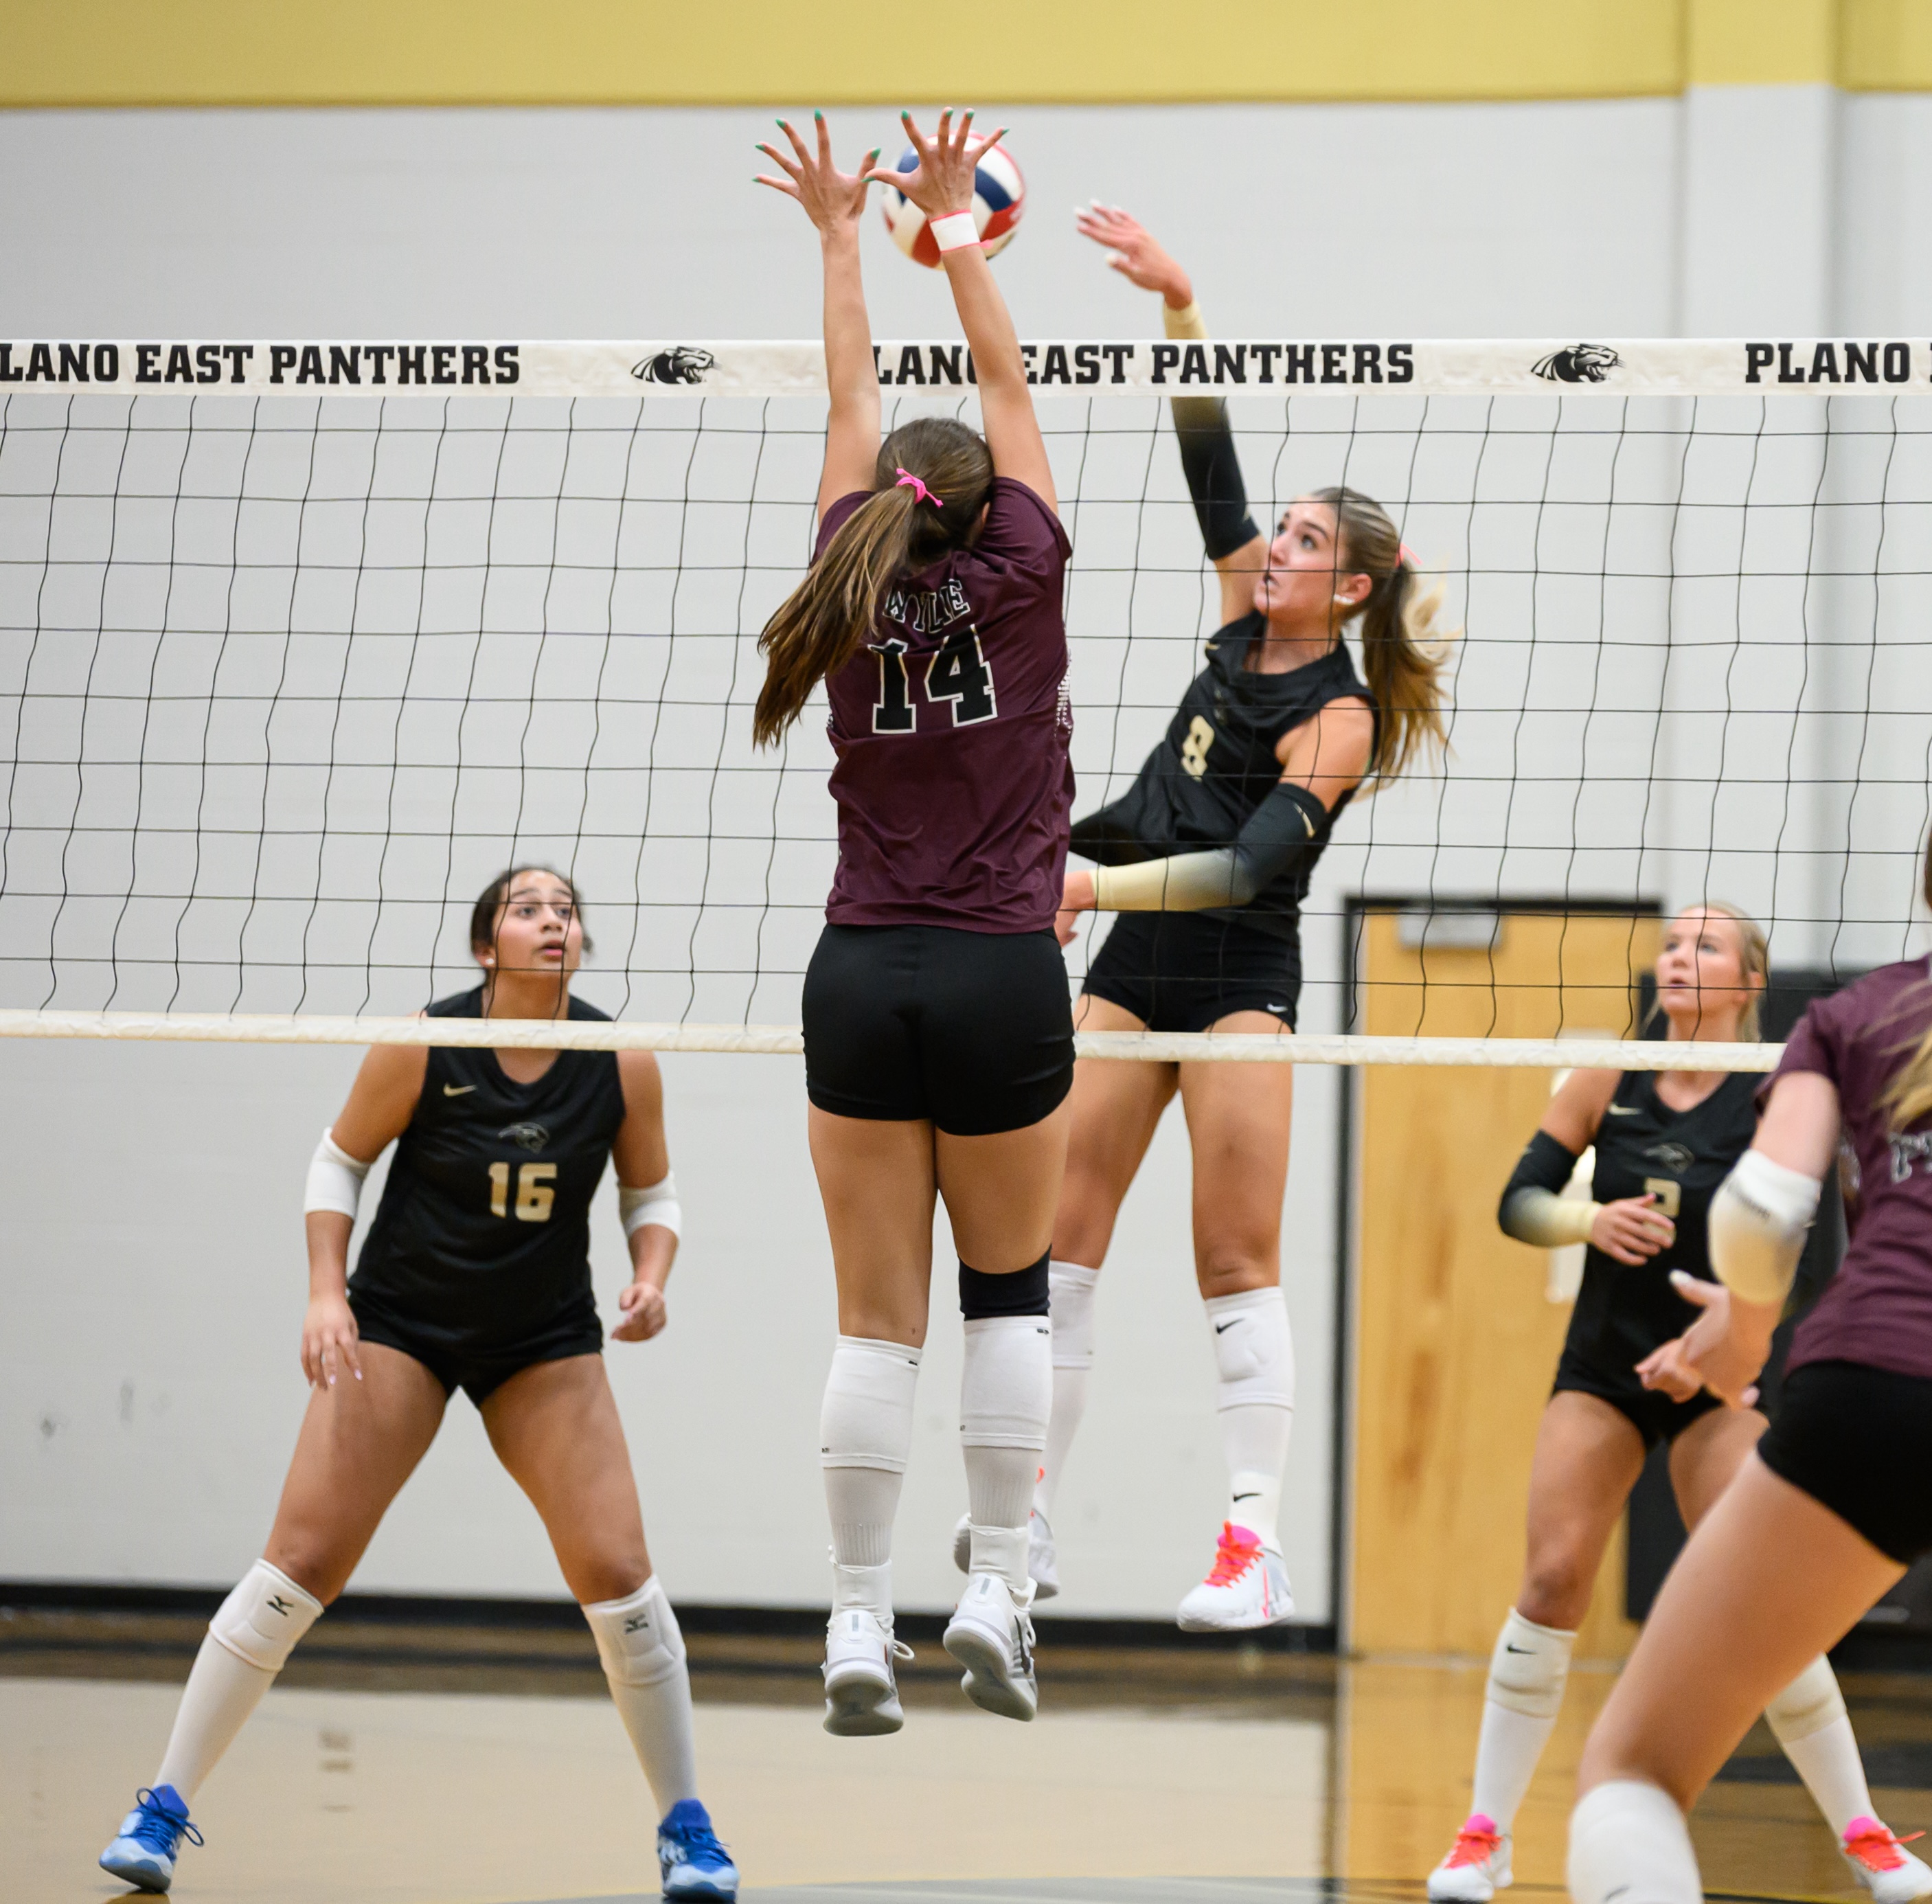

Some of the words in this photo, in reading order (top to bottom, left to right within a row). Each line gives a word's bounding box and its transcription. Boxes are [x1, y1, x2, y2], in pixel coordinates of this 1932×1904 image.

[0, 343, 119, 382] LANO
[135, 345, 253, 383] EAST
[269, 345, 519, 385] PANTHERS
[1019, 345, 1134, 385] EAST
[1151, 344, 1413, 384] PANTHERS
[1745, 343, 1910, 383] PLANO
[867, 624, 998, 734] 14
[1181, 714, 1215, 782] 8
[488, 1161, 558, 1222] 16
